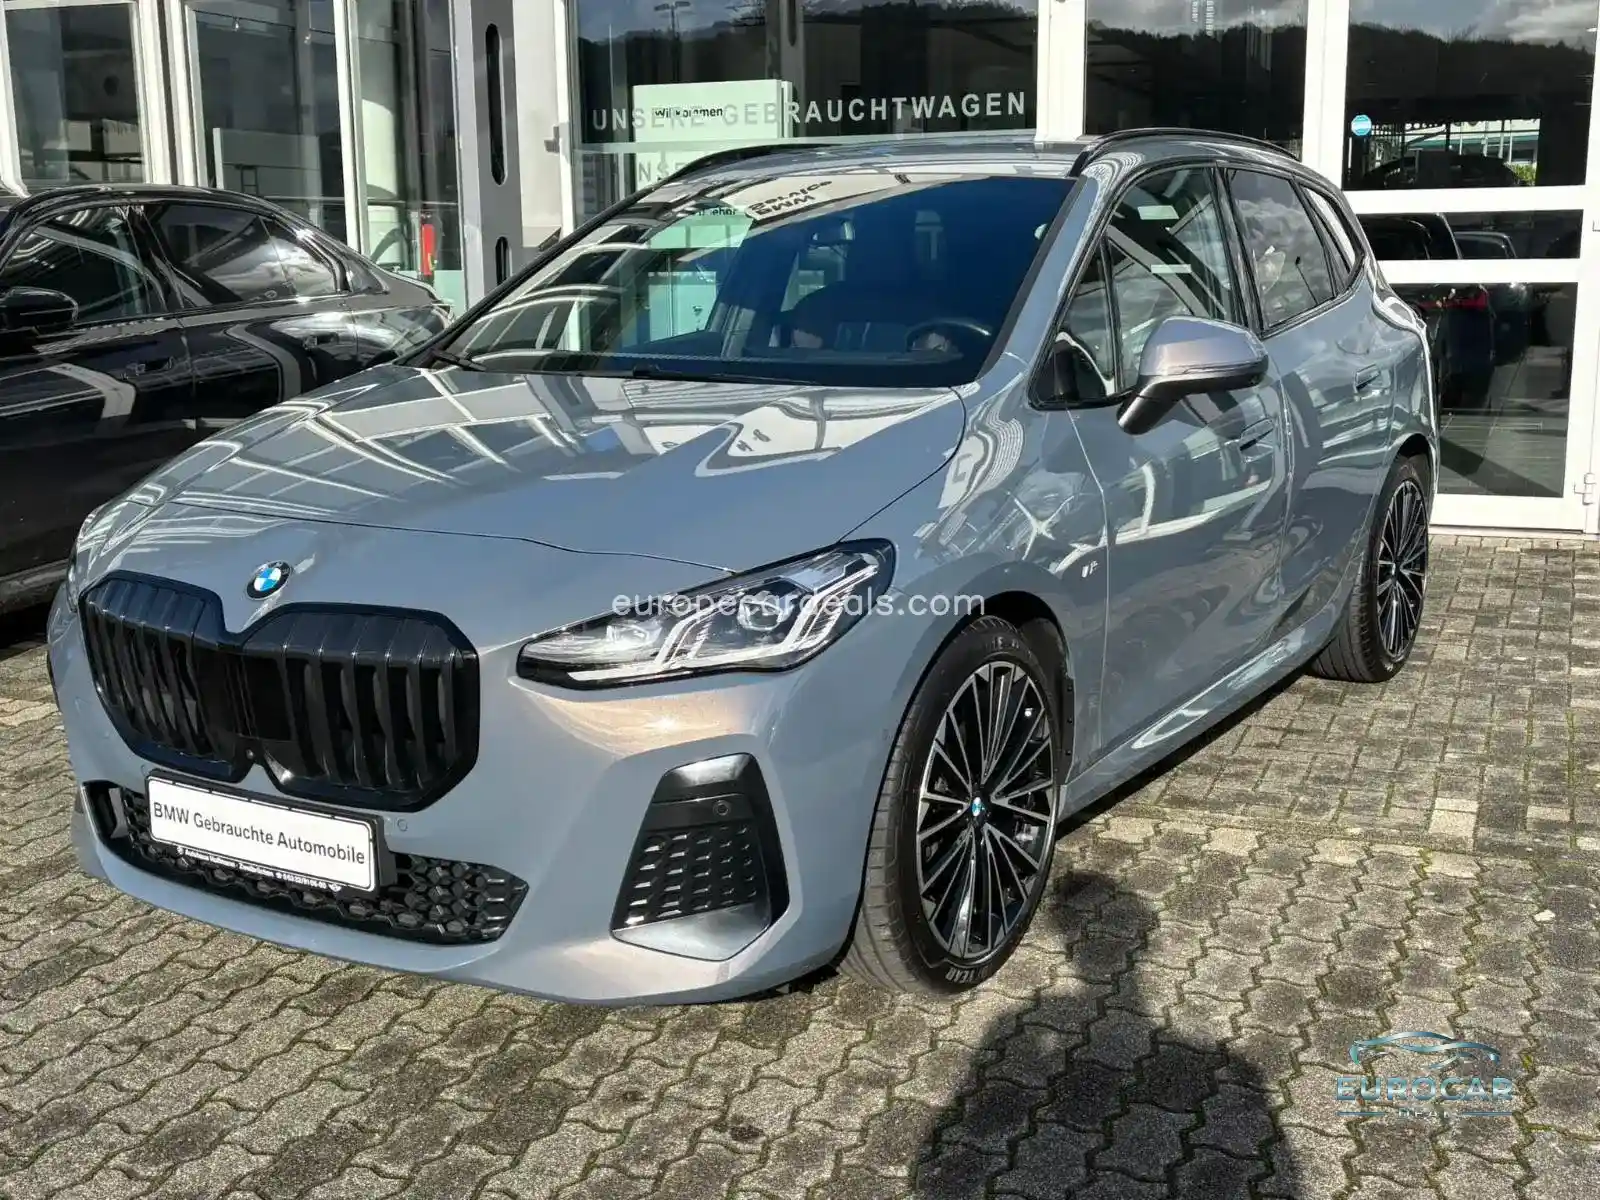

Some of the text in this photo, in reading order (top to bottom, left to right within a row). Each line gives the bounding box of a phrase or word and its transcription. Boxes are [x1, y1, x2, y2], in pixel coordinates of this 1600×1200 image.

[592, 91, 1026, 131] UNSERE GEBRAUCHTWAGEN
[153, 802, 365, 865] BMW Gebrauchte Automobile
